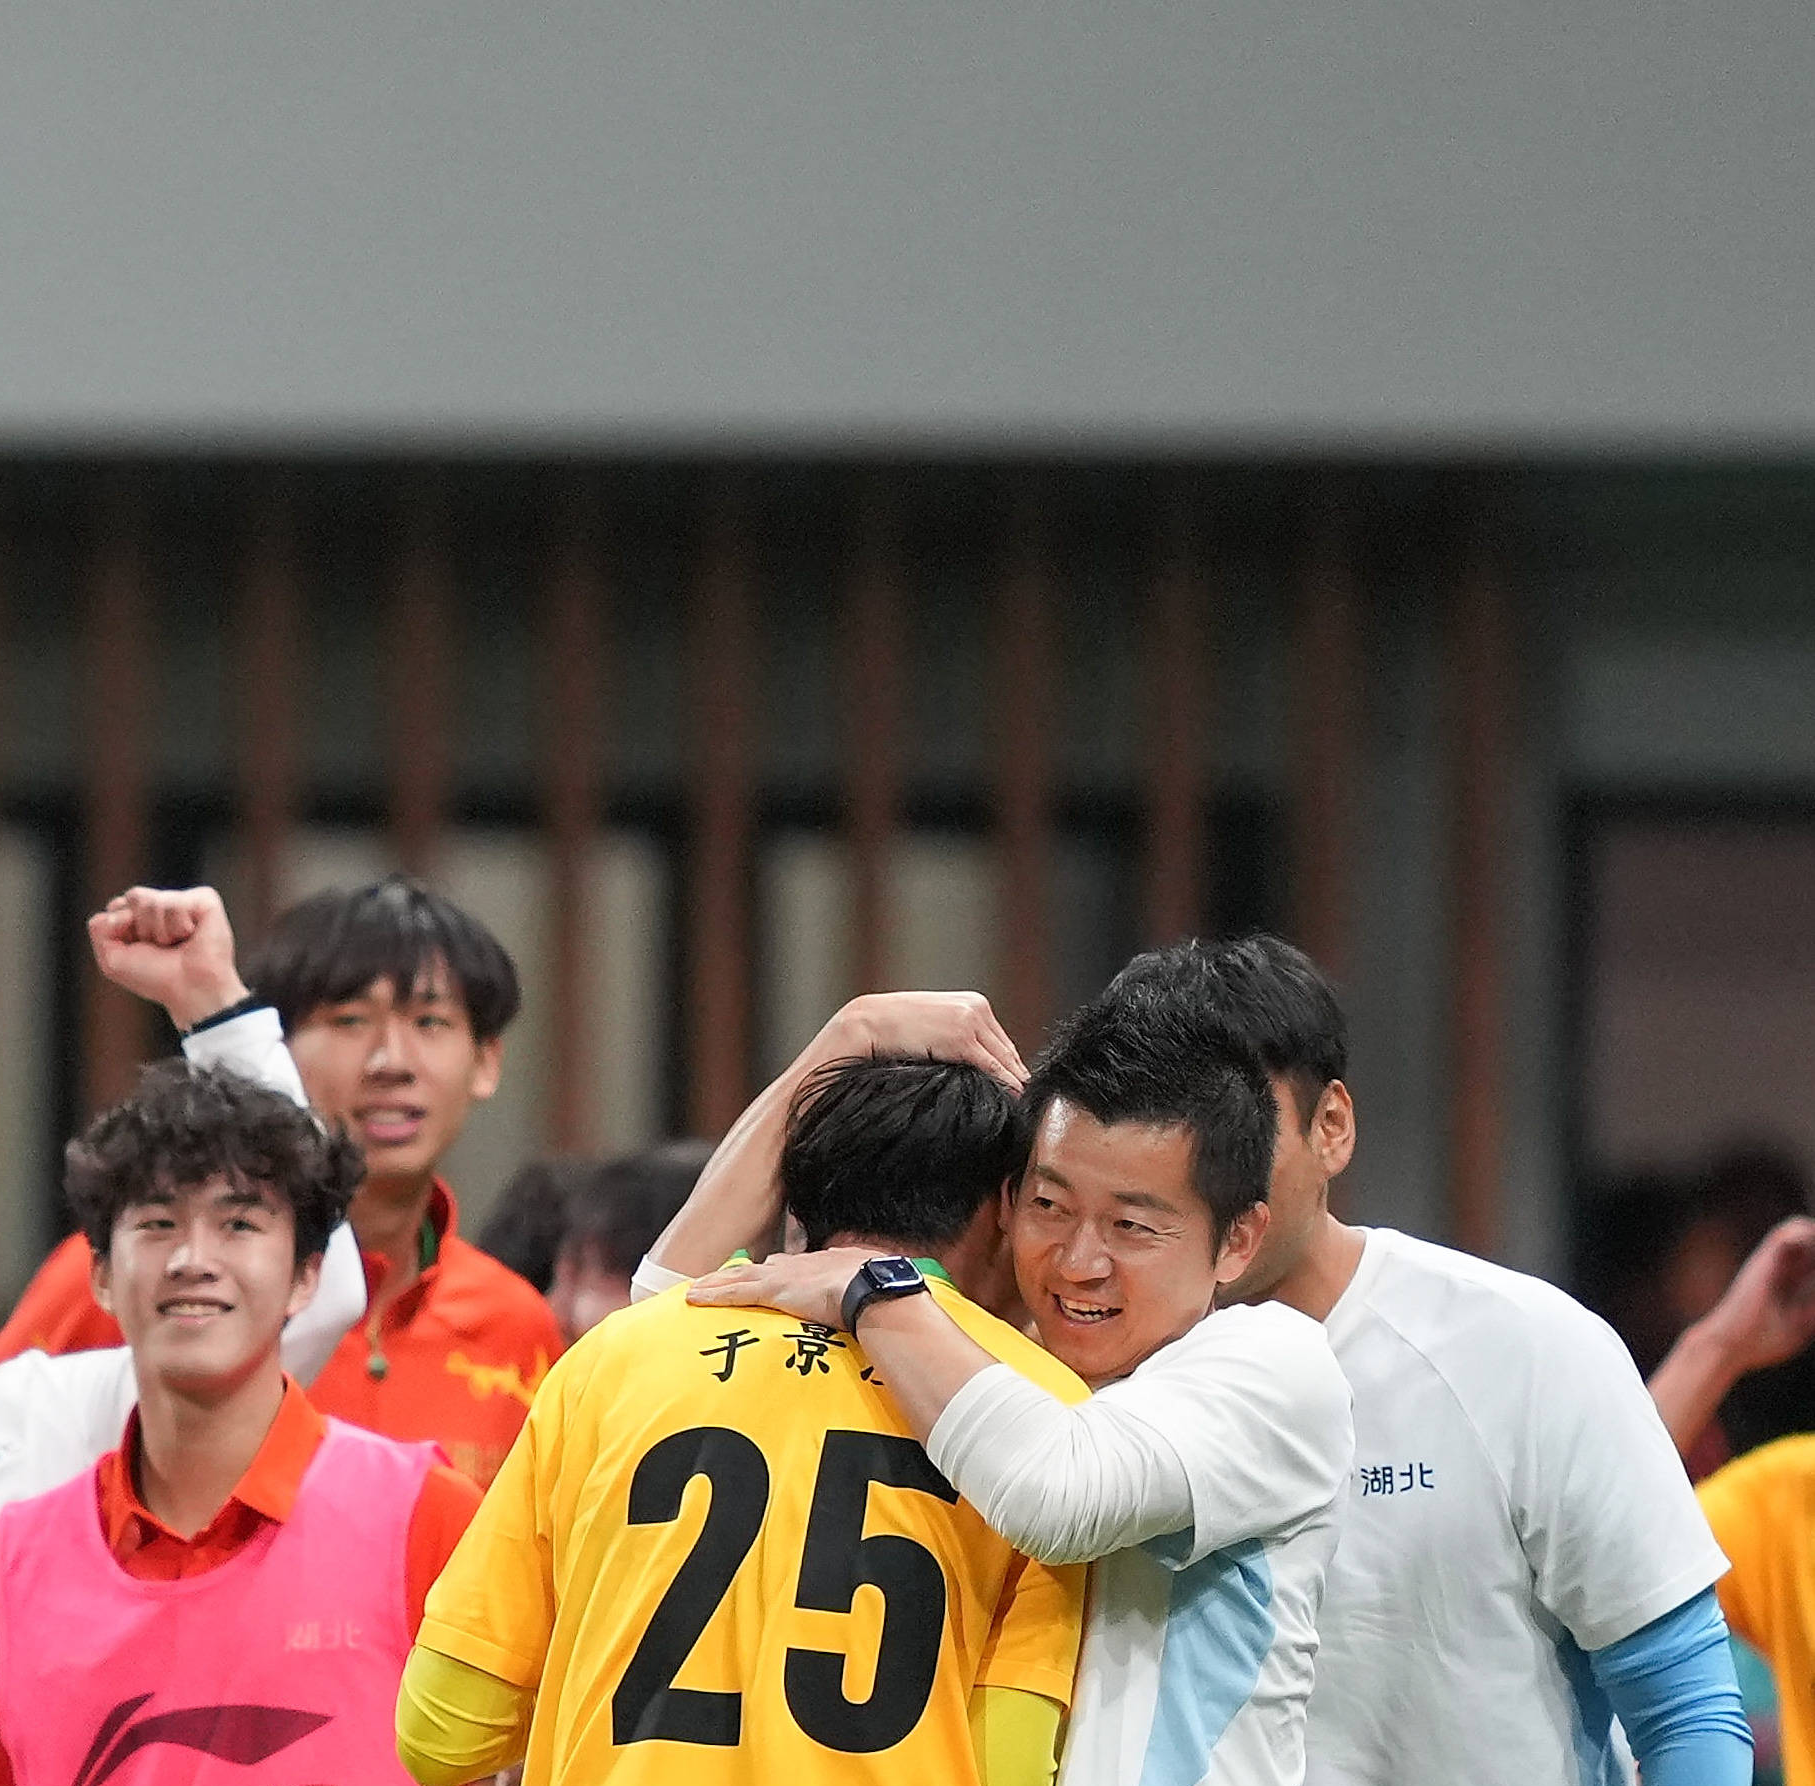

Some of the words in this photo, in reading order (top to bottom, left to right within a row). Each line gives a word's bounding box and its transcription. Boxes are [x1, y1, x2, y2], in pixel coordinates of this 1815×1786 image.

[698, 1321, 885, 1384] 于景
[1360, 1461, 1435, 1497] 湖北
[611, 1425, 960, 1755] 25
